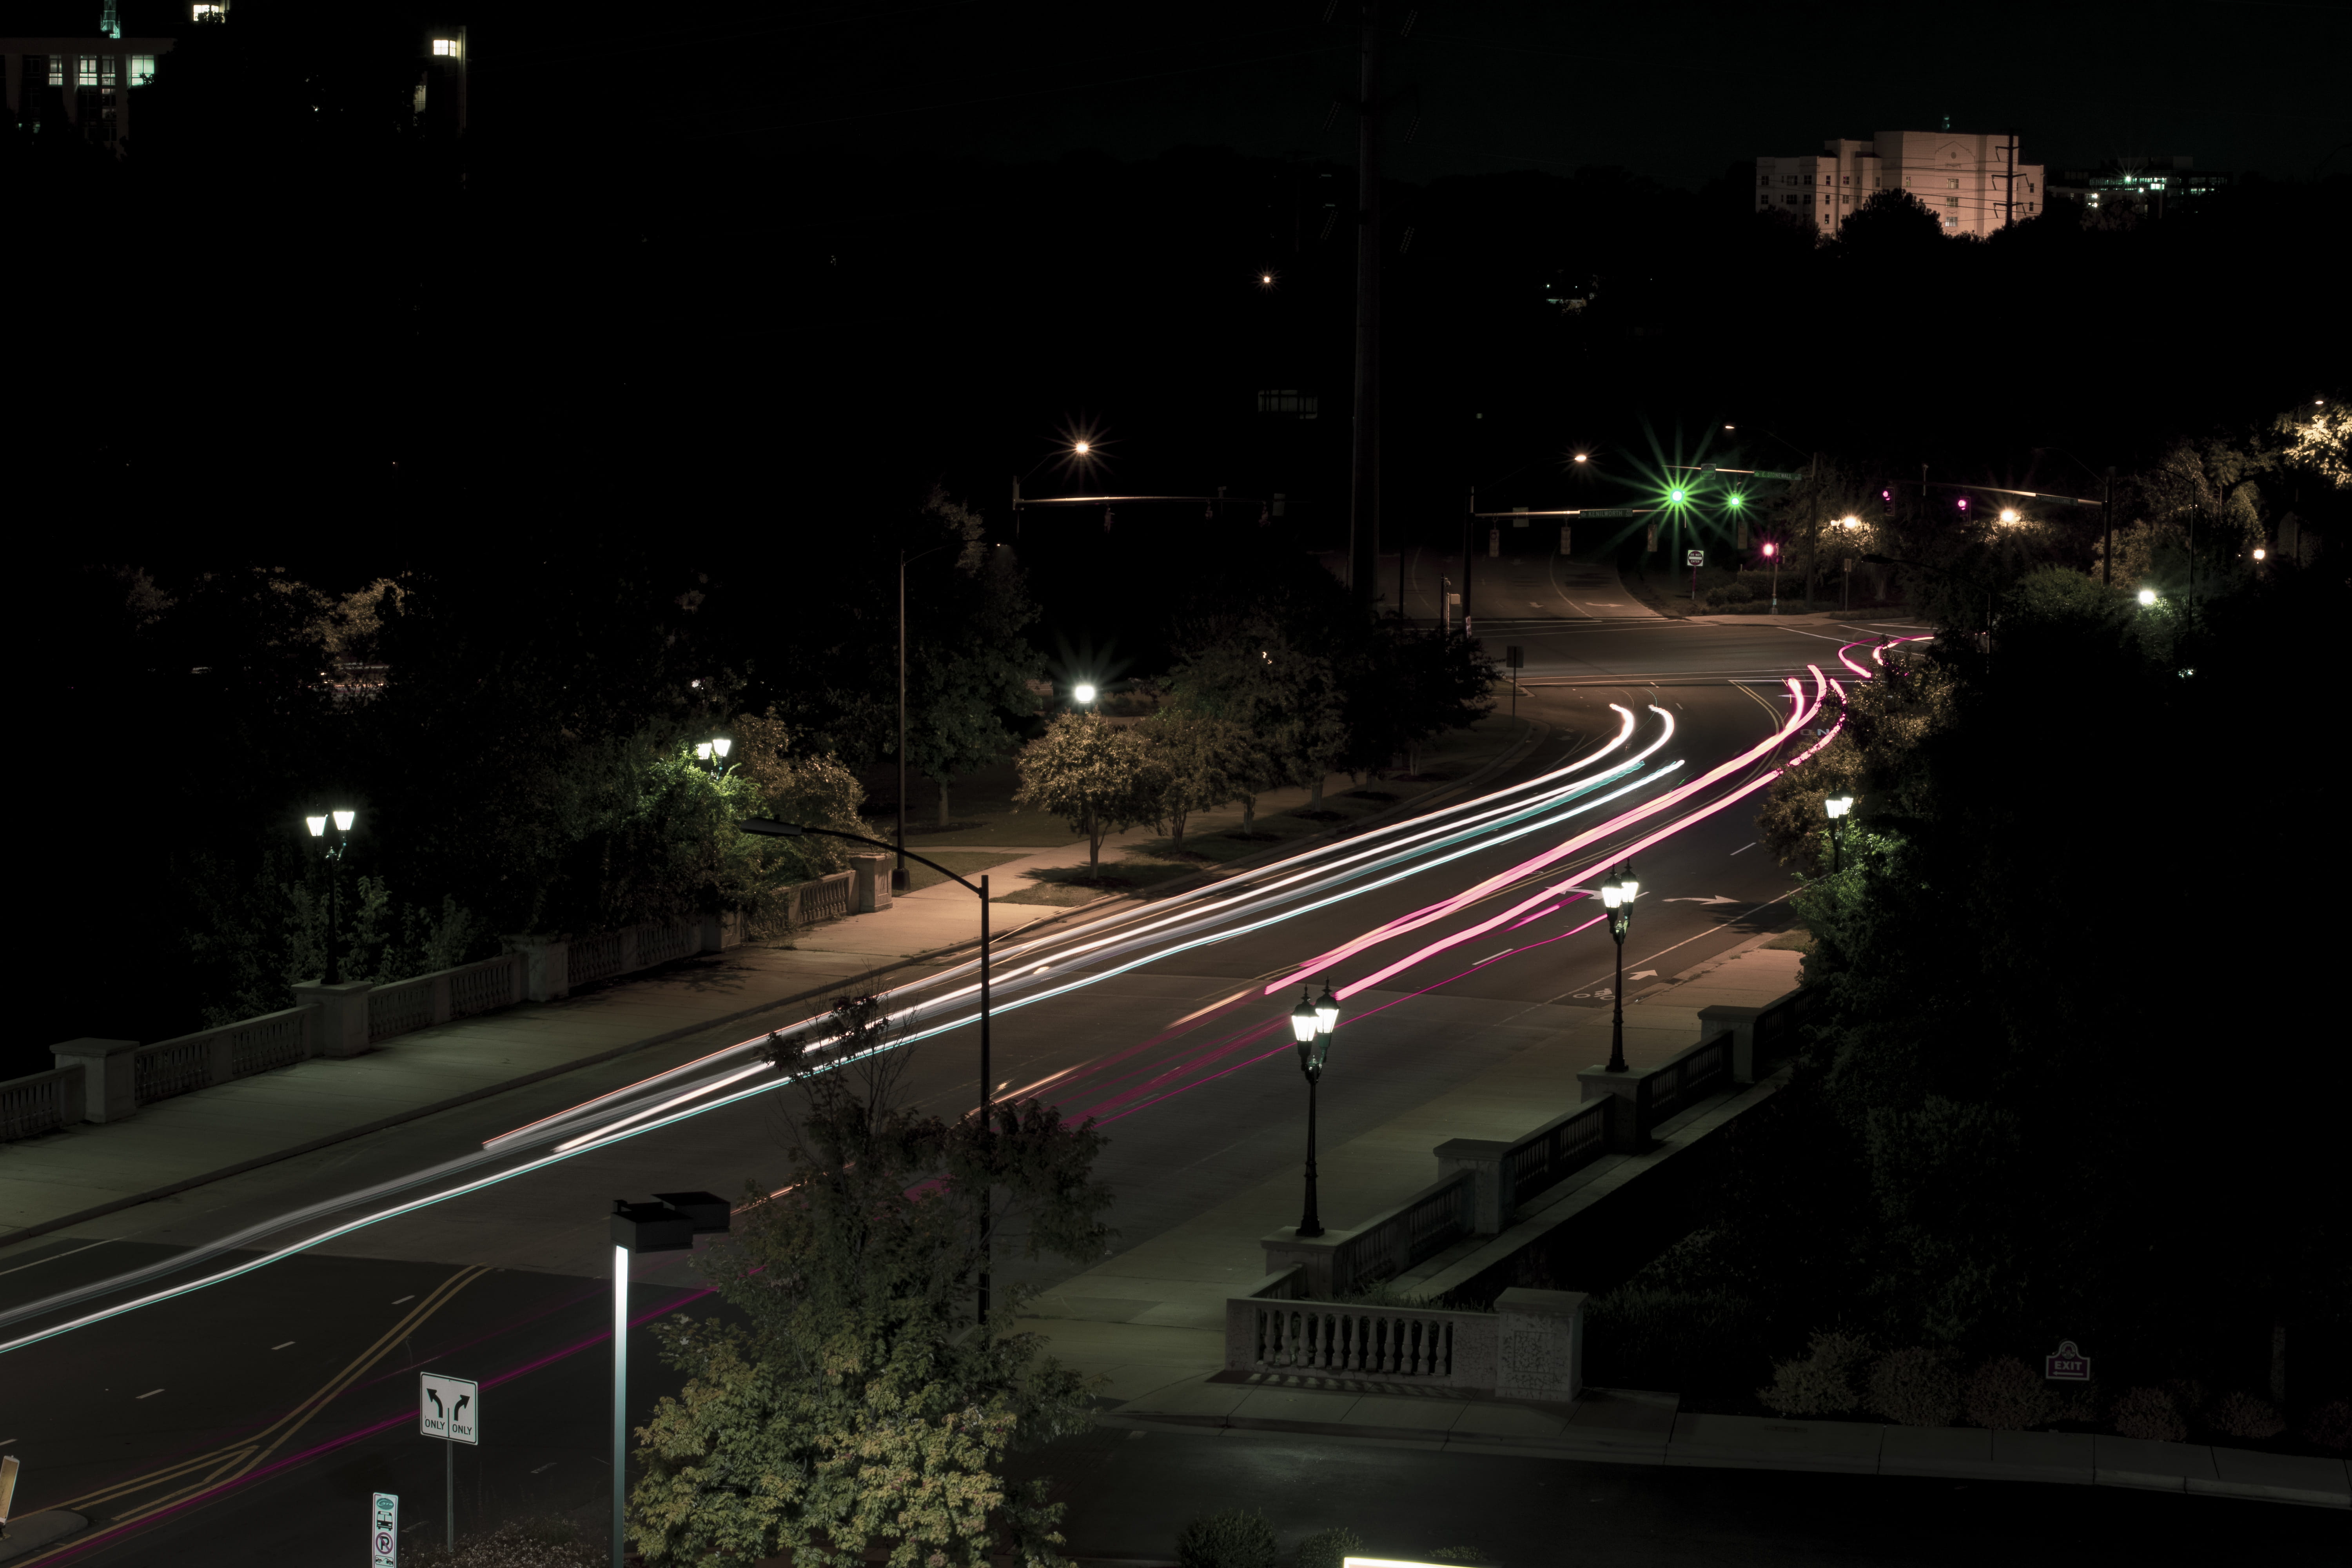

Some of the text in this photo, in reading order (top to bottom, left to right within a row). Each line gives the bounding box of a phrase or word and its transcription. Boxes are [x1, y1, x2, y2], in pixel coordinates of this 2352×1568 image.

[2054, 1361, 2082, 1370] EXIT
[425, 1419, 445, 1430] ONLY
[452, 1424, 472, 1435] ONLY
